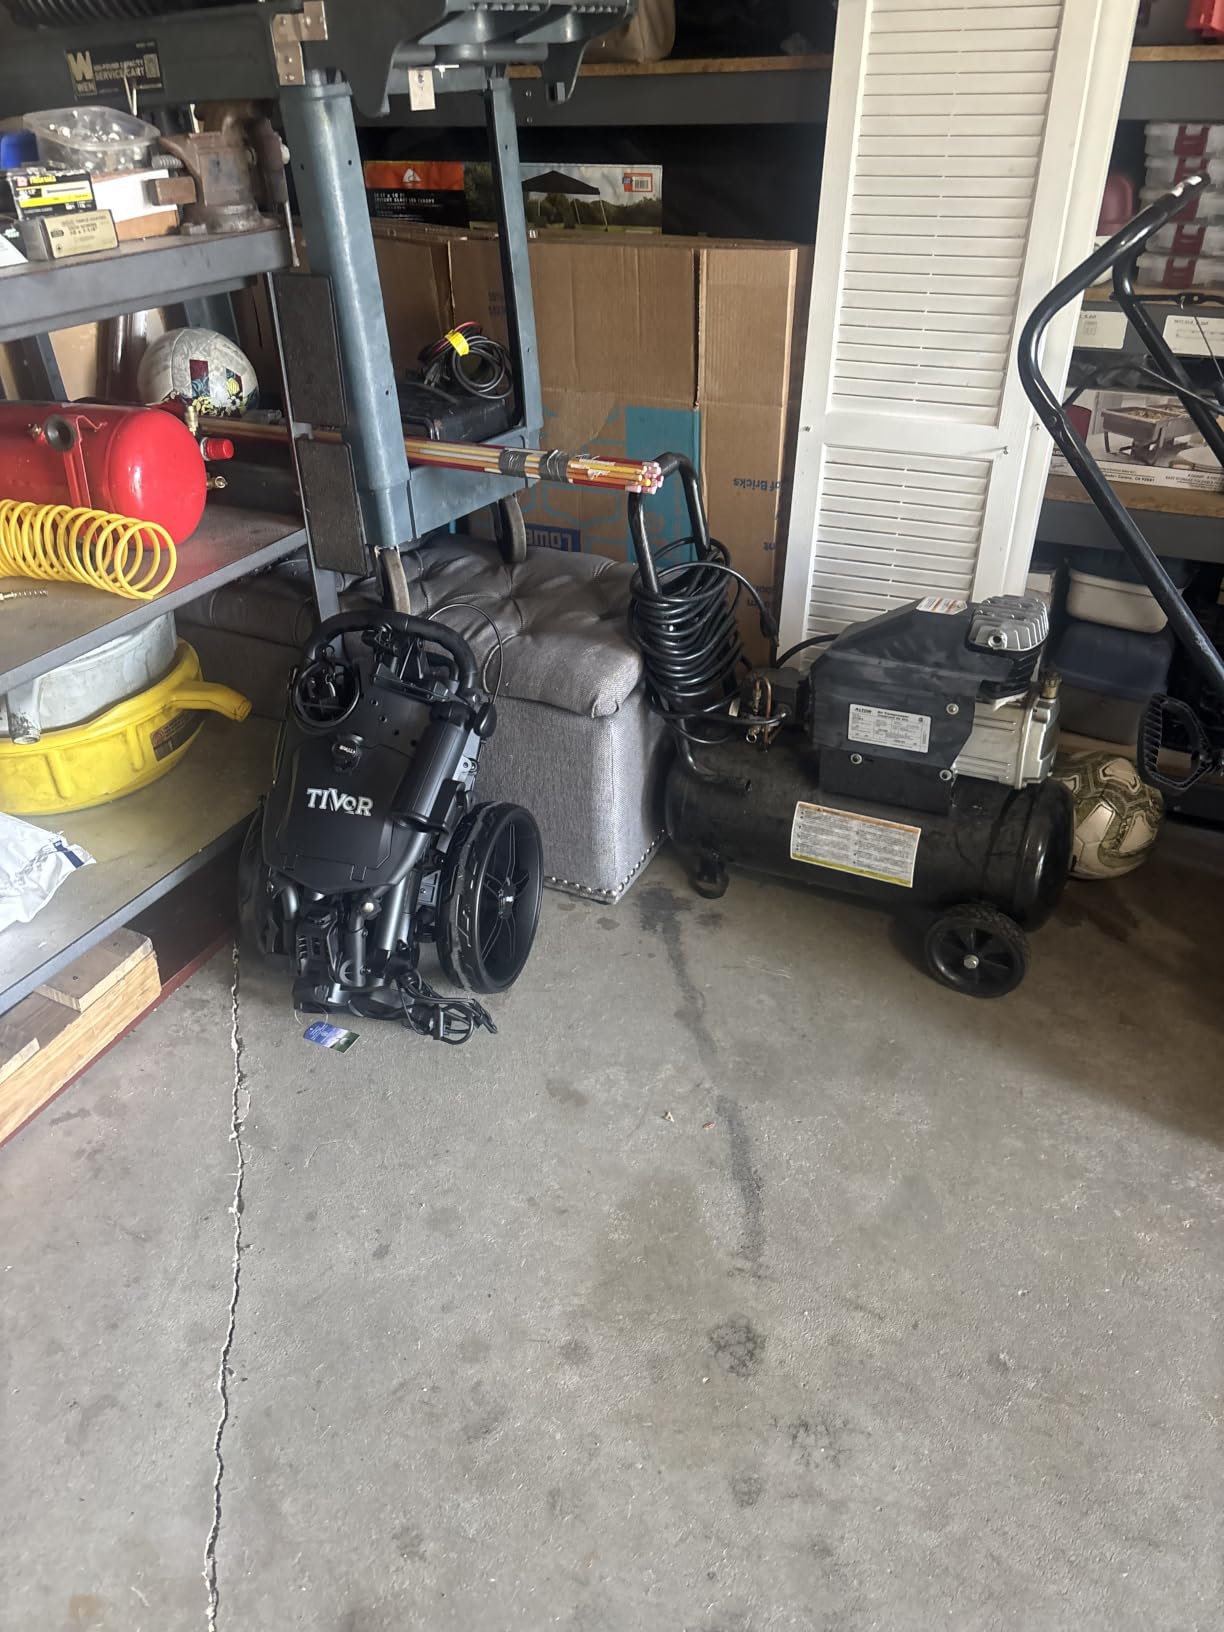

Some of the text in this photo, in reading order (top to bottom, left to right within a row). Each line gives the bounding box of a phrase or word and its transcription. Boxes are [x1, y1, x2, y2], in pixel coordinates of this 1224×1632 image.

[94, 67, 146, 81] SERVICE CART
[733, 478, 768, 491] Bricks
